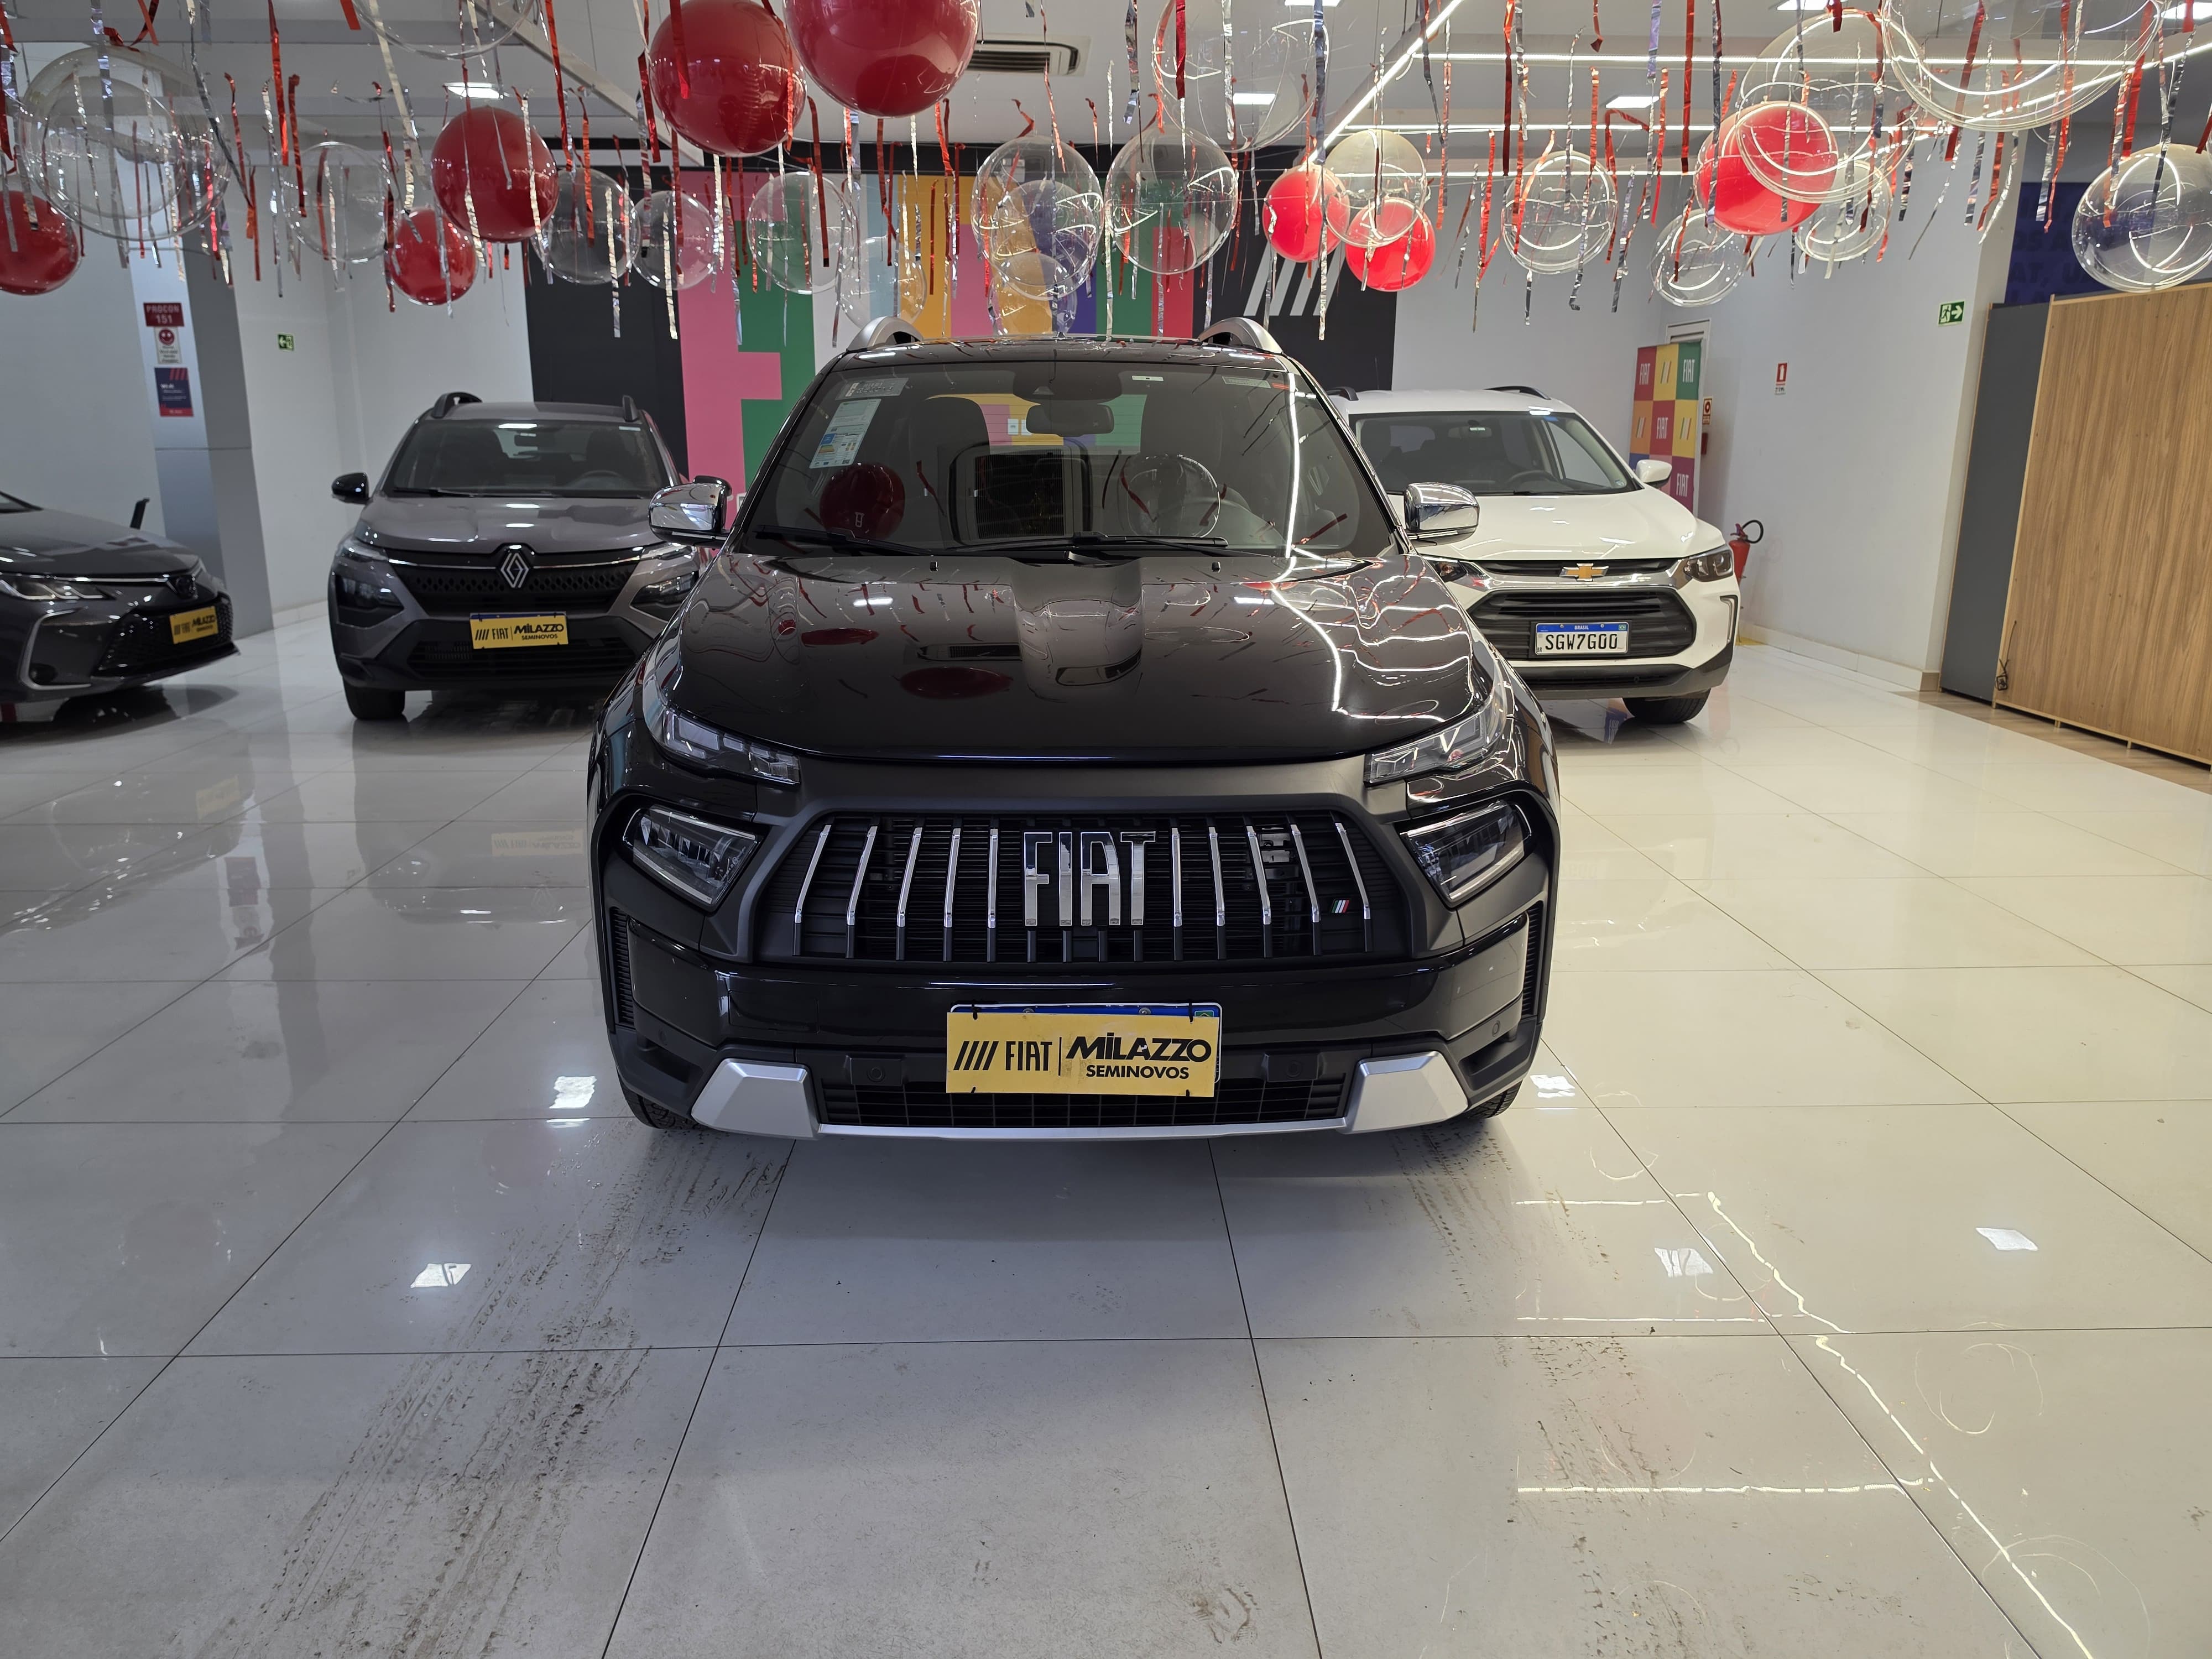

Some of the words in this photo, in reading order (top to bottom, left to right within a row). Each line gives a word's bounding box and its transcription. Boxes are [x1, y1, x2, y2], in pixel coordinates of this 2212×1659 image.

[146, 305, 180, 314] PROCON
[156, 314, 173, 324] 151
[1639, 363, 1651, 385] FIAT
[1683, 359, 1695, 383] FIAT
[1656, 417, 1668, 440] FIAT
[1676, 473, 1689, 497] FIAT
[492, 628, 509, 640] FIAT
[1024, 831, 1156, 926] FIAT
[1005, 1041, 1053, 1071] FIAT
[1086, 1064, 1190, 1080] SEMINOVOS
